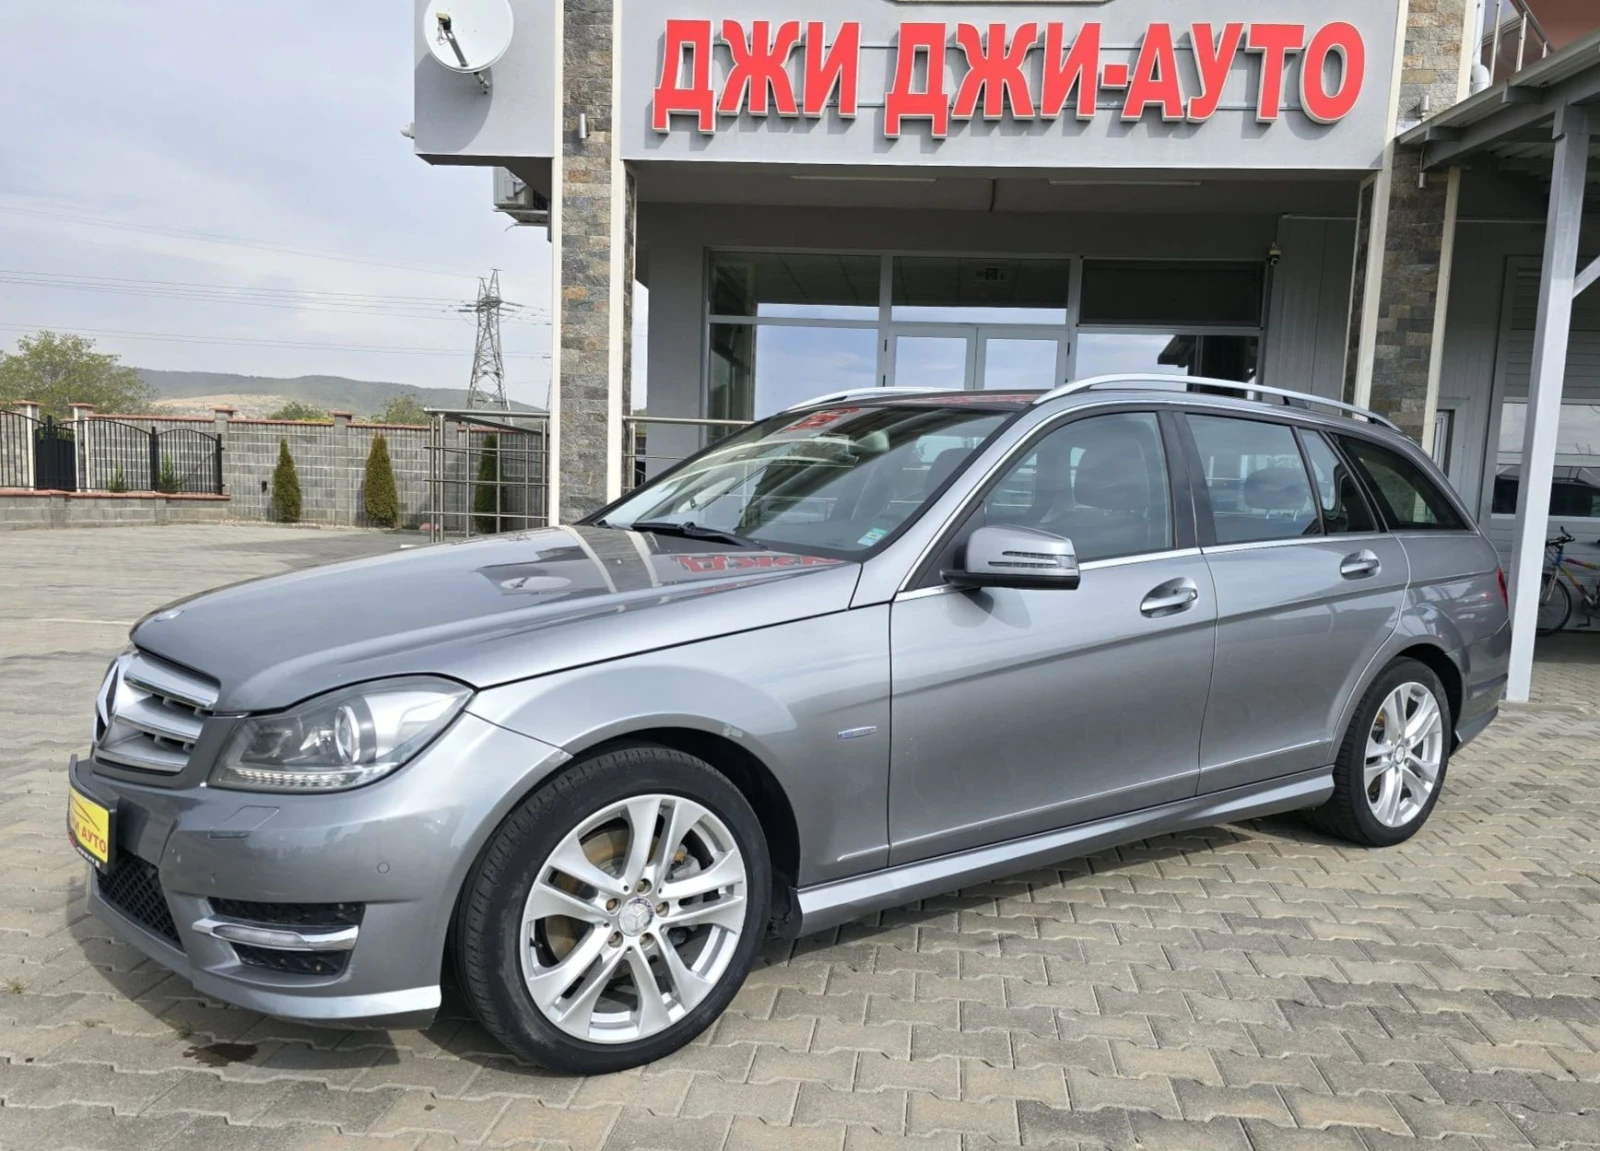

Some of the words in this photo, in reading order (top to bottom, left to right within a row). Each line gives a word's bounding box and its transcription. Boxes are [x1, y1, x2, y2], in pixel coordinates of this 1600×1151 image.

[651, 19, 860, 134] ДЖИ
[883, 21, 1367, 139] ДЖИ-АУТО
[81, 826, 107, 853] АУТО
